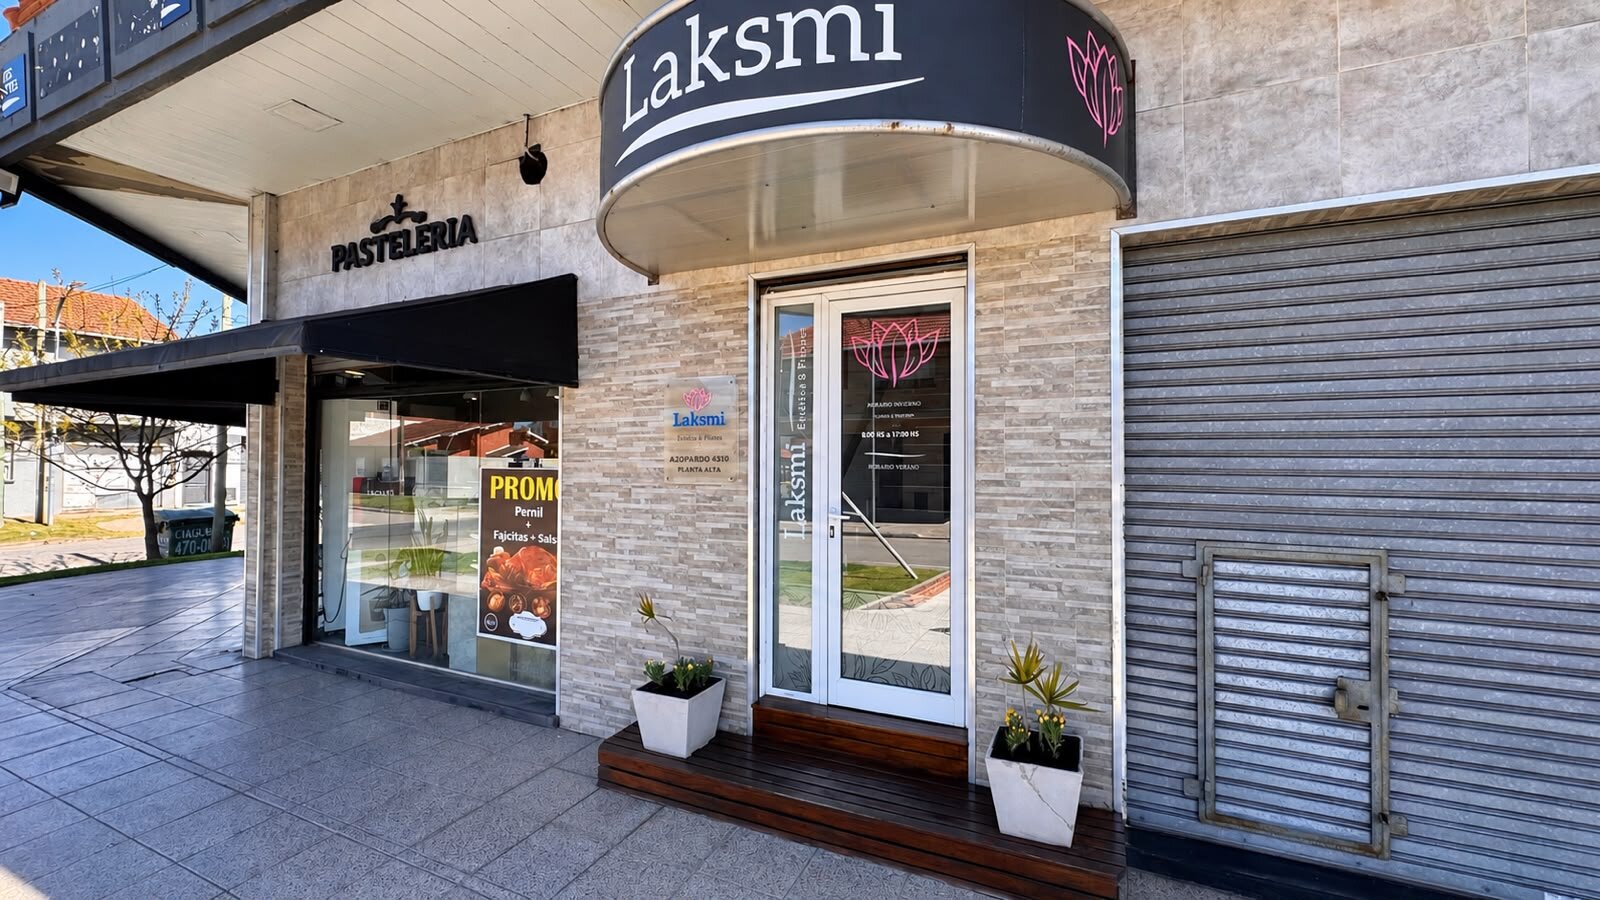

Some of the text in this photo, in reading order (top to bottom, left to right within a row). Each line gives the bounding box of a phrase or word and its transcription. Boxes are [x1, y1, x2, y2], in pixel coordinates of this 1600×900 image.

[622, 3, 902, 132] Laksmi
[331, 214, 479, 272] PASTELERIA
[672, 411, 726, 427] Laksmi
[515, 506, 543, 518] Pernil
[783, 442, 806, 540] Laksmi
